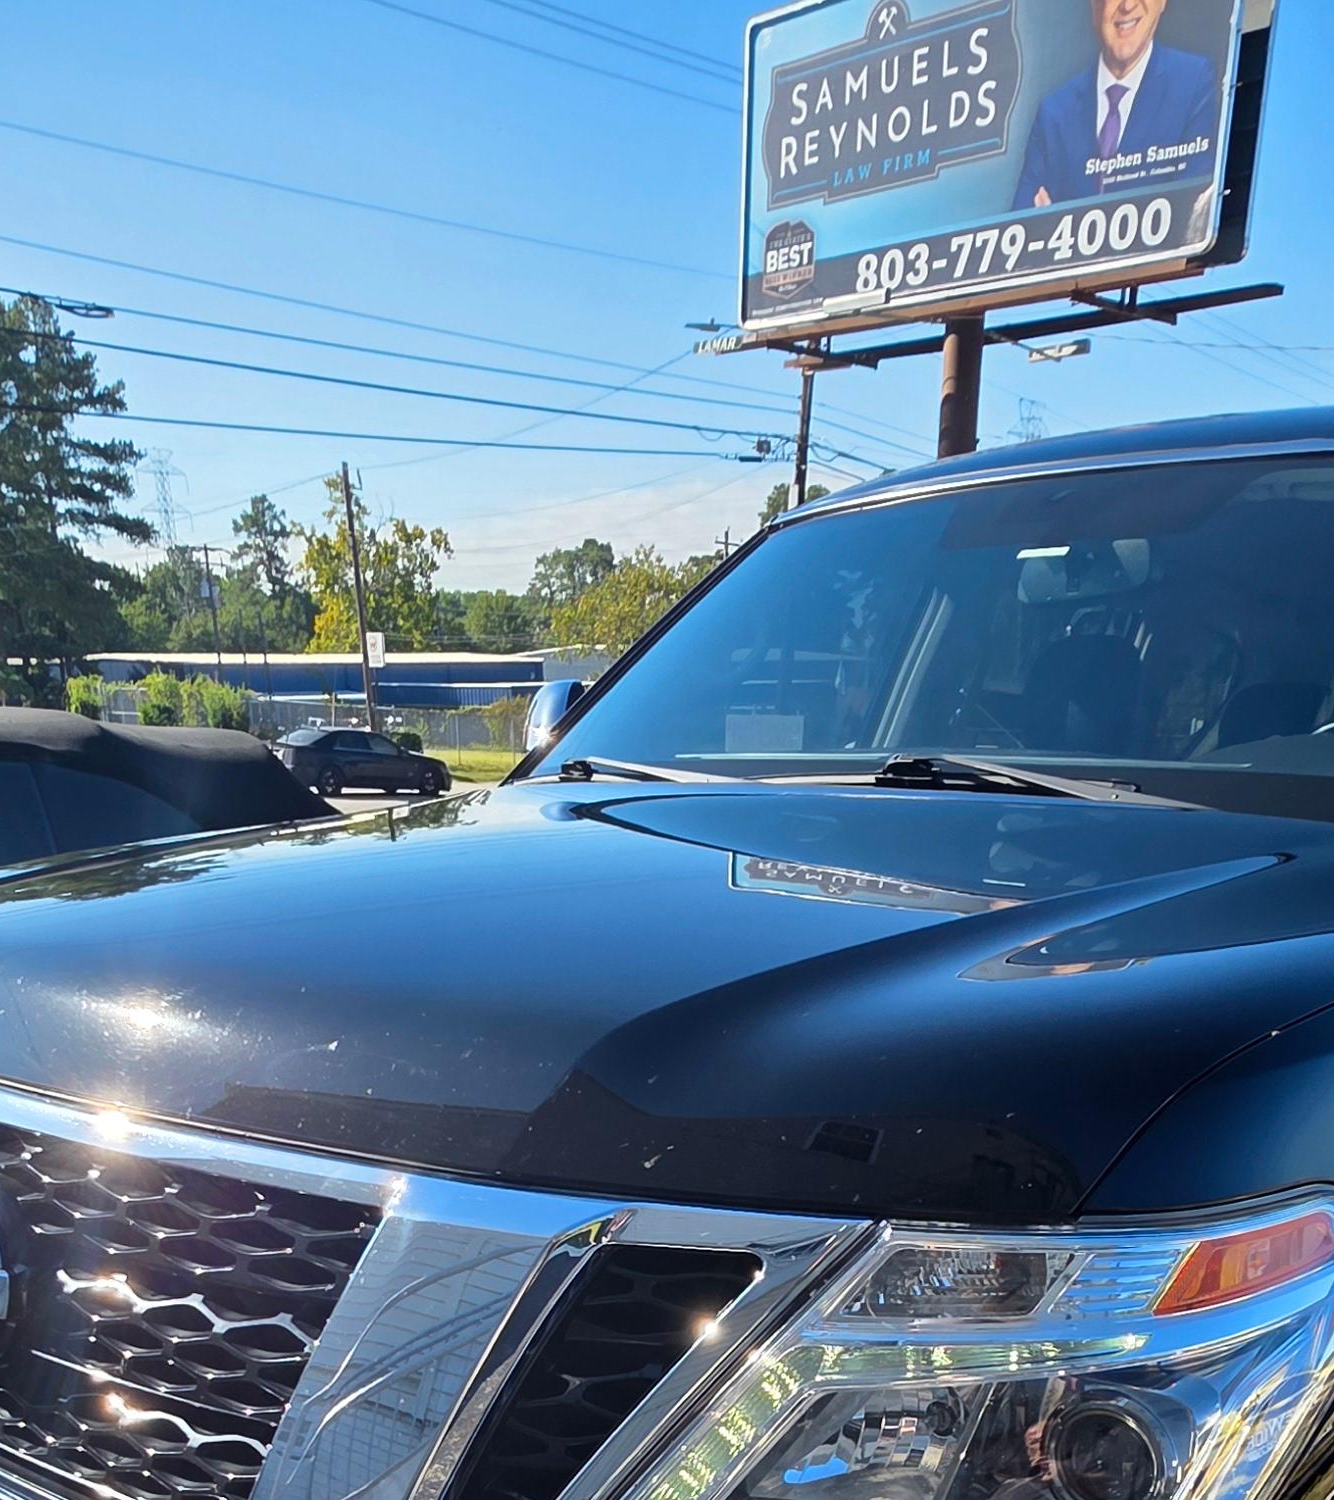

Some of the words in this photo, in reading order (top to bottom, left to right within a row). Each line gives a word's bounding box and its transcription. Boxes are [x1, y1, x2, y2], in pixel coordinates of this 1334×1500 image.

[790, 28, 989, 126] SAMUELS
[779, 80, 998, 178] REYNOLDS
[832, 163, 872, 186] LAW
[882, 149, 931, 175] FIRM
[1085, 152, 1142, 175] Stephen
[1146, 136, 1210, 162] Samuels
[766, 241, 812, 273] BEST
[855, 198, 1172, 293] 803-779-4000
[698, 337, 736, 353] LAMAR
